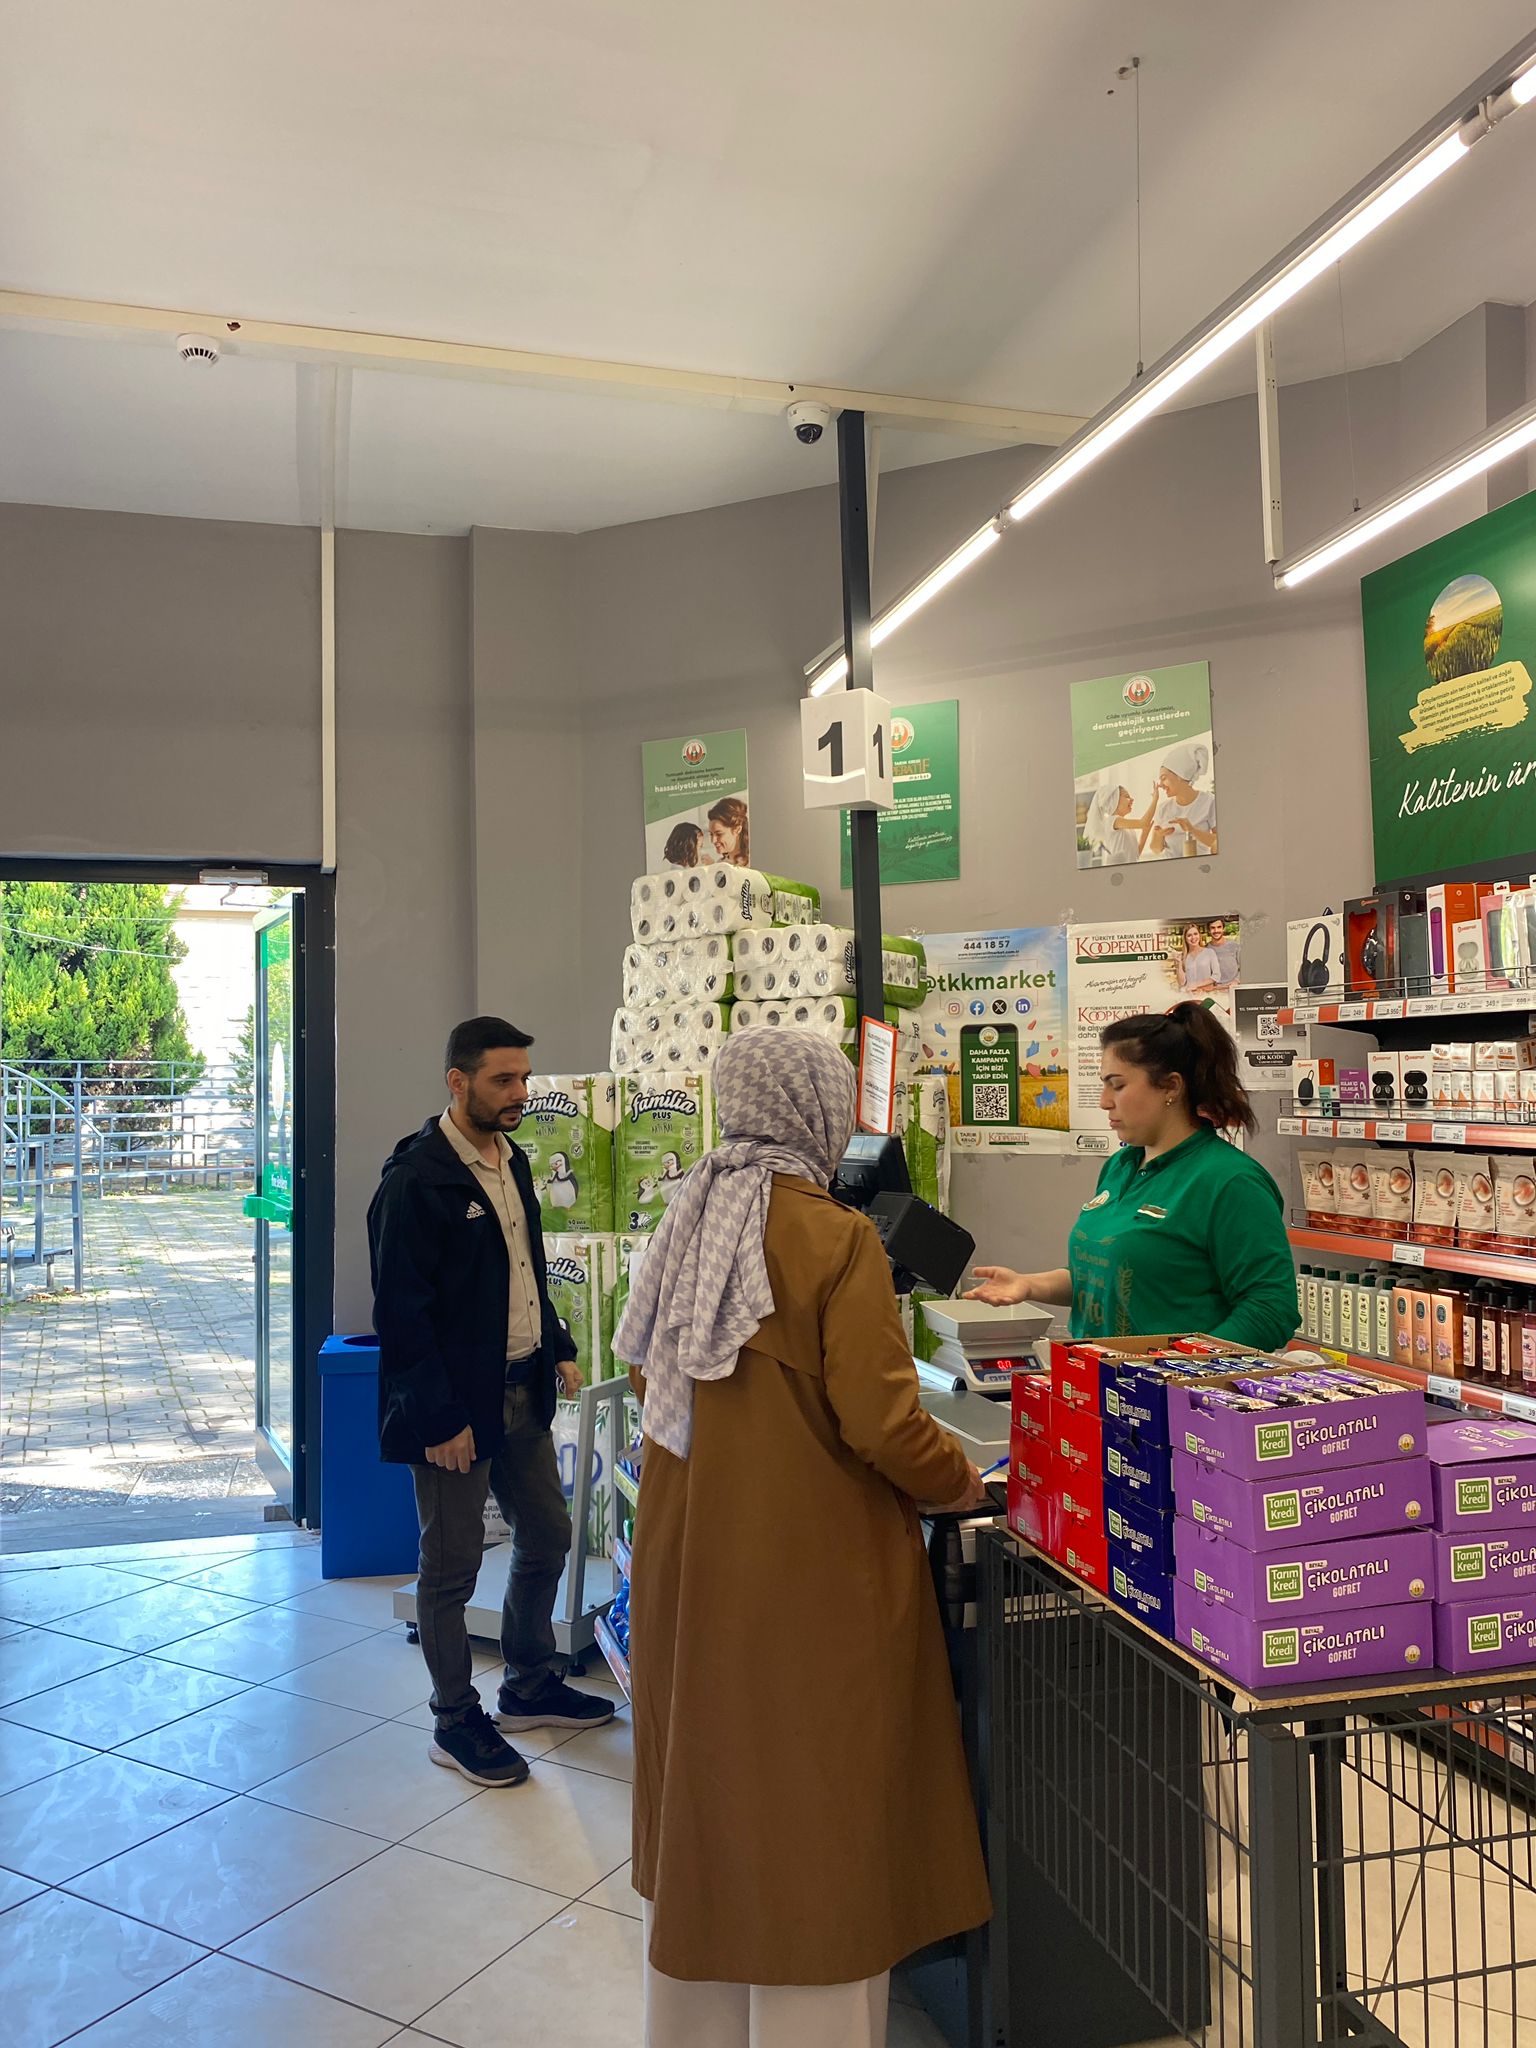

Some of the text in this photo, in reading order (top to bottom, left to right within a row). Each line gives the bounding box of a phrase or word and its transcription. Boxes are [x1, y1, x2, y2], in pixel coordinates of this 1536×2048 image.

[1092, 710, 1190, 731] dermatolojik testlerden
[1118, 723, 1165, 738] geçiriyoruz
[818, 721, 843, 777] 1
[873, 724, 884, 779] 1
[655, 781, 698, 792] hassasiyetle
[699, 777, 736, 788] üretiyoruz
[1398, 766, 1502, 818] Kalitenin
[964, 940, 1010, 950] 444 18 57
[926, 969, 1056, 994] @tkkmarket
[1077, 1031, 1097, 1039] daha
[976, 1064, 990, 1072] İÇİN
[522, 1091, 578, 1118] amilia
[631, 1089, 696, 1123] familia
[536, 1114, 556, 1122] PLUS
[546, 1277, 562, 1286] LUS
[1260, 1428, 1288, 1439] Tarım
[1296, 1415, 1377, 1450] ÇİKOLATALI
[1262, 1438, 1286, 1451] Kredi
[1321, 1439, 1351, 1455] GOFRET
[1460, 1483, 1488, 1494] Tarım
[1267, 1496, 1296, 1509] Tarım
[1304, 1482, 1385, 1519] ÇİKOLATALI
[1462, 1493, 1487, 1505] Kredi
[1271, 1507, 1295, 1520] Kredi
[1330, 1506, 1359, 1524] GOFRET
[1455, 1550, 1481, 1561] Tarım
[1457, 1560, 1480, 1572] Kredi
[1271, 1568, 1299, 1580] Tarım
[1307, 1558, 1390, 1592] ÇİKOLATALI
[1273, 1579, 1298, 1591] Kredi
[1332, 1581, 1362, 1598] GOFRET
[1472, 1620, 1497, 1632] Tarım
[1267, 1634, 1295, 1646] Tarım
[1303, 1624, 1385, 1658] ÇİKOLATALI
[1474, 1632, 1496, 1643] Kredi
[1269, 1644, 1293, 1657] Kredi
[1328, 1647, 1358, 1664] GOFRET
